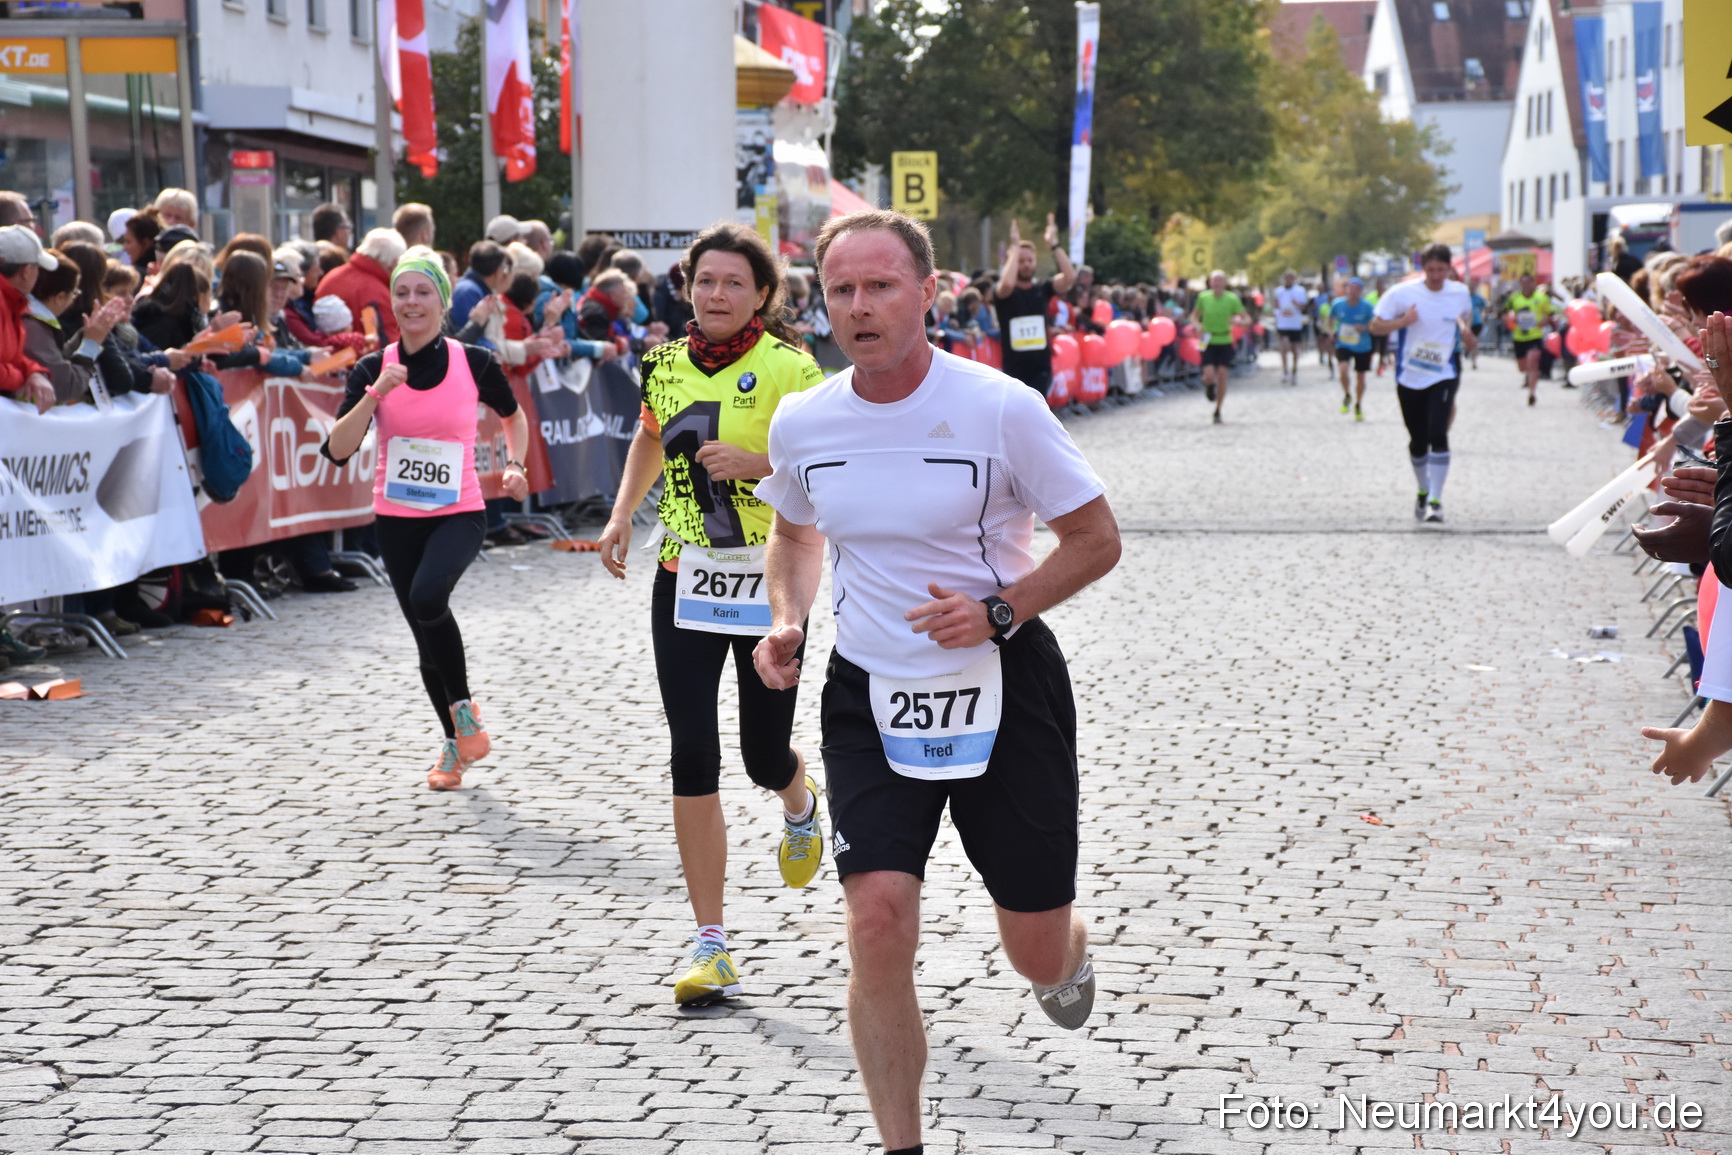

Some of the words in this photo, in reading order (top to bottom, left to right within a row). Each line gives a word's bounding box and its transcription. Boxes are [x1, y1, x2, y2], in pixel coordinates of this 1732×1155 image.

[905, 173, 925, 203] B
[1192, 247, 1206, 266] C
[733, 395, 756, 405] Partl
[397, 458, 450, 485] 2596
[405, 487, 437, 499] Stefanie
[716, 552, 751, 561] BOCK
[691, 568, 764, 598] 2677
[712, 606, 740, 619] Karin
[889, 686, 981, 730] 2577
[923, 742, 953, 758] Fred
